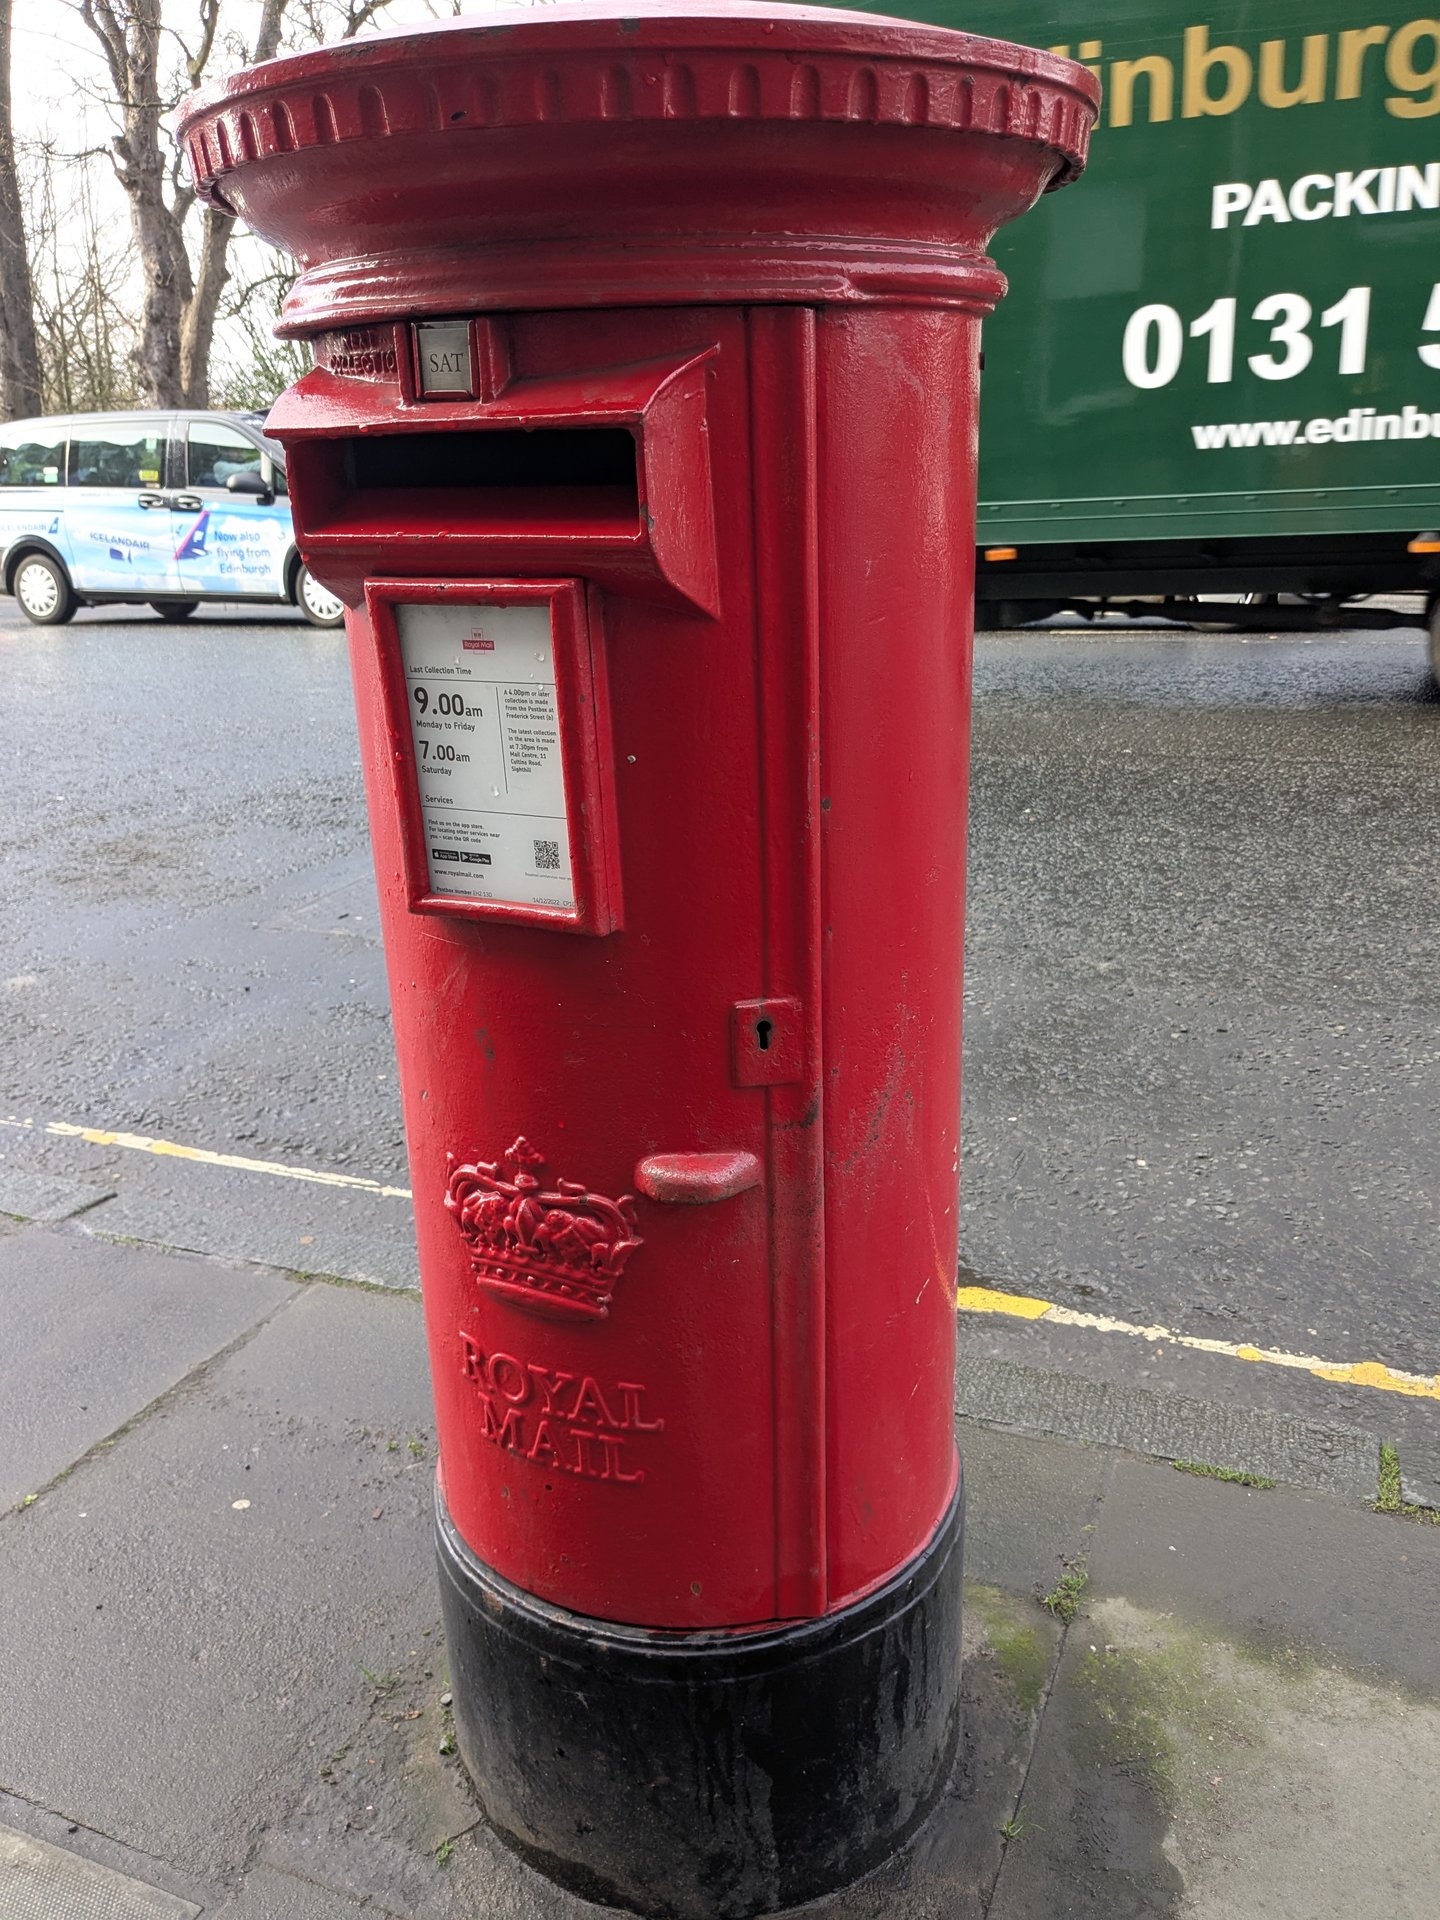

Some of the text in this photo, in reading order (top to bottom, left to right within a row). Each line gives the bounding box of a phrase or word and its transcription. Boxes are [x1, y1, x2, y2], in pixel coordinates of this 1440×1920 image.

[1211, 162, 1440, 229] PACKIN
[1122, 287, 1371, 389] 0131
[430, 353, 463, 373] SAT
[89, 531, 150, 550] ICELANDAIR
[214, 531, 261, 541] Now also
[217, 547, 271, 561] flying from
[409, 665, 472, 675] Last Collection Time
[508, 688, 531, 697] 4.00pm
[413, 686, 483, 717] 9.00am
[534, 698, 549, 706] made
[505, 704, 518, 712] from
[506, 712, 529, 720] Frederick
[529, 713, 546, 721] Street
[416, 720, 476, 732] Monday to Friday
[517, 728, 533, 736] latest
[532, 729, 557, 737] collection
[418, 740, 471, 763] 7.00am
[421, 765, 453, 777] Saturday
[425, 794, 454, 805] Services
[434, 869, 485, 879] www.royalmail.com
[459, 1330, 665, 1431] ROYAL
[478, 1391, 645, 1483] MAIL
